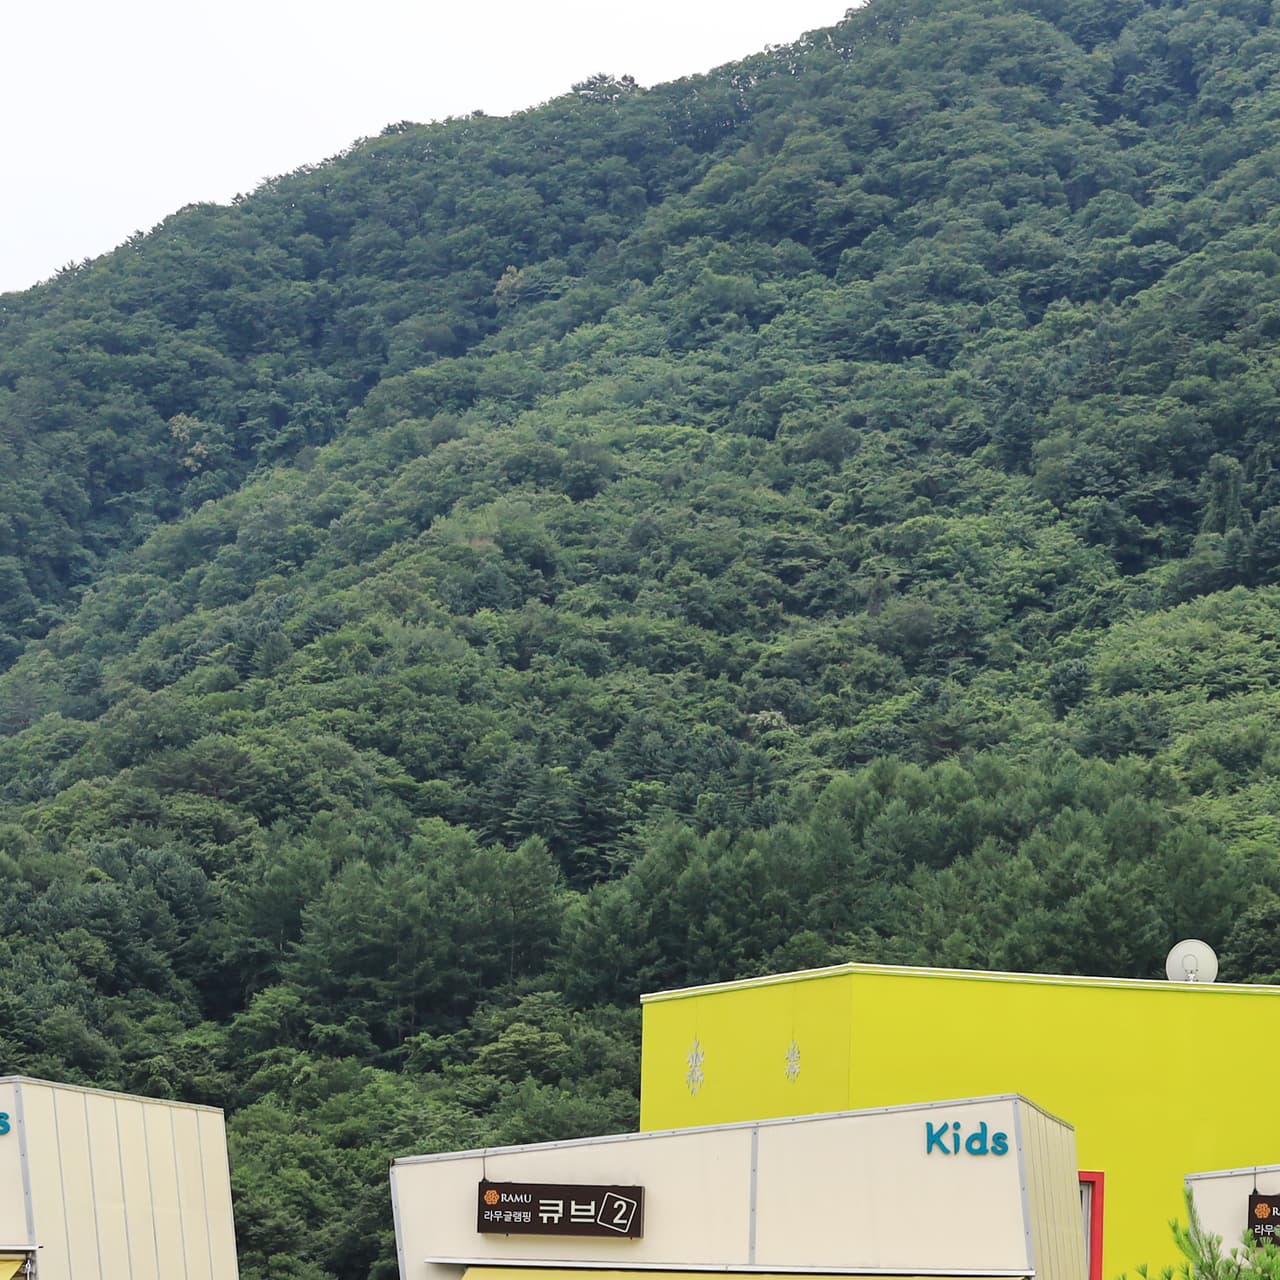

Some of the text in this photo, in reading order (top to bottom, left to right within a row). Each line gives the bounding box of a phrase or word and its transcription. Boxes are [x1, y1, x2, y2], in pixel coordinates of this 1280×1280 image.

[926, 1121, 1009, 1155] Kids
[500, 1193, 532, 1204] RAMU
[483, 1210, 532, 1223] 라무글램핑
[539, 1199, 628, 1224] 큐브 2
